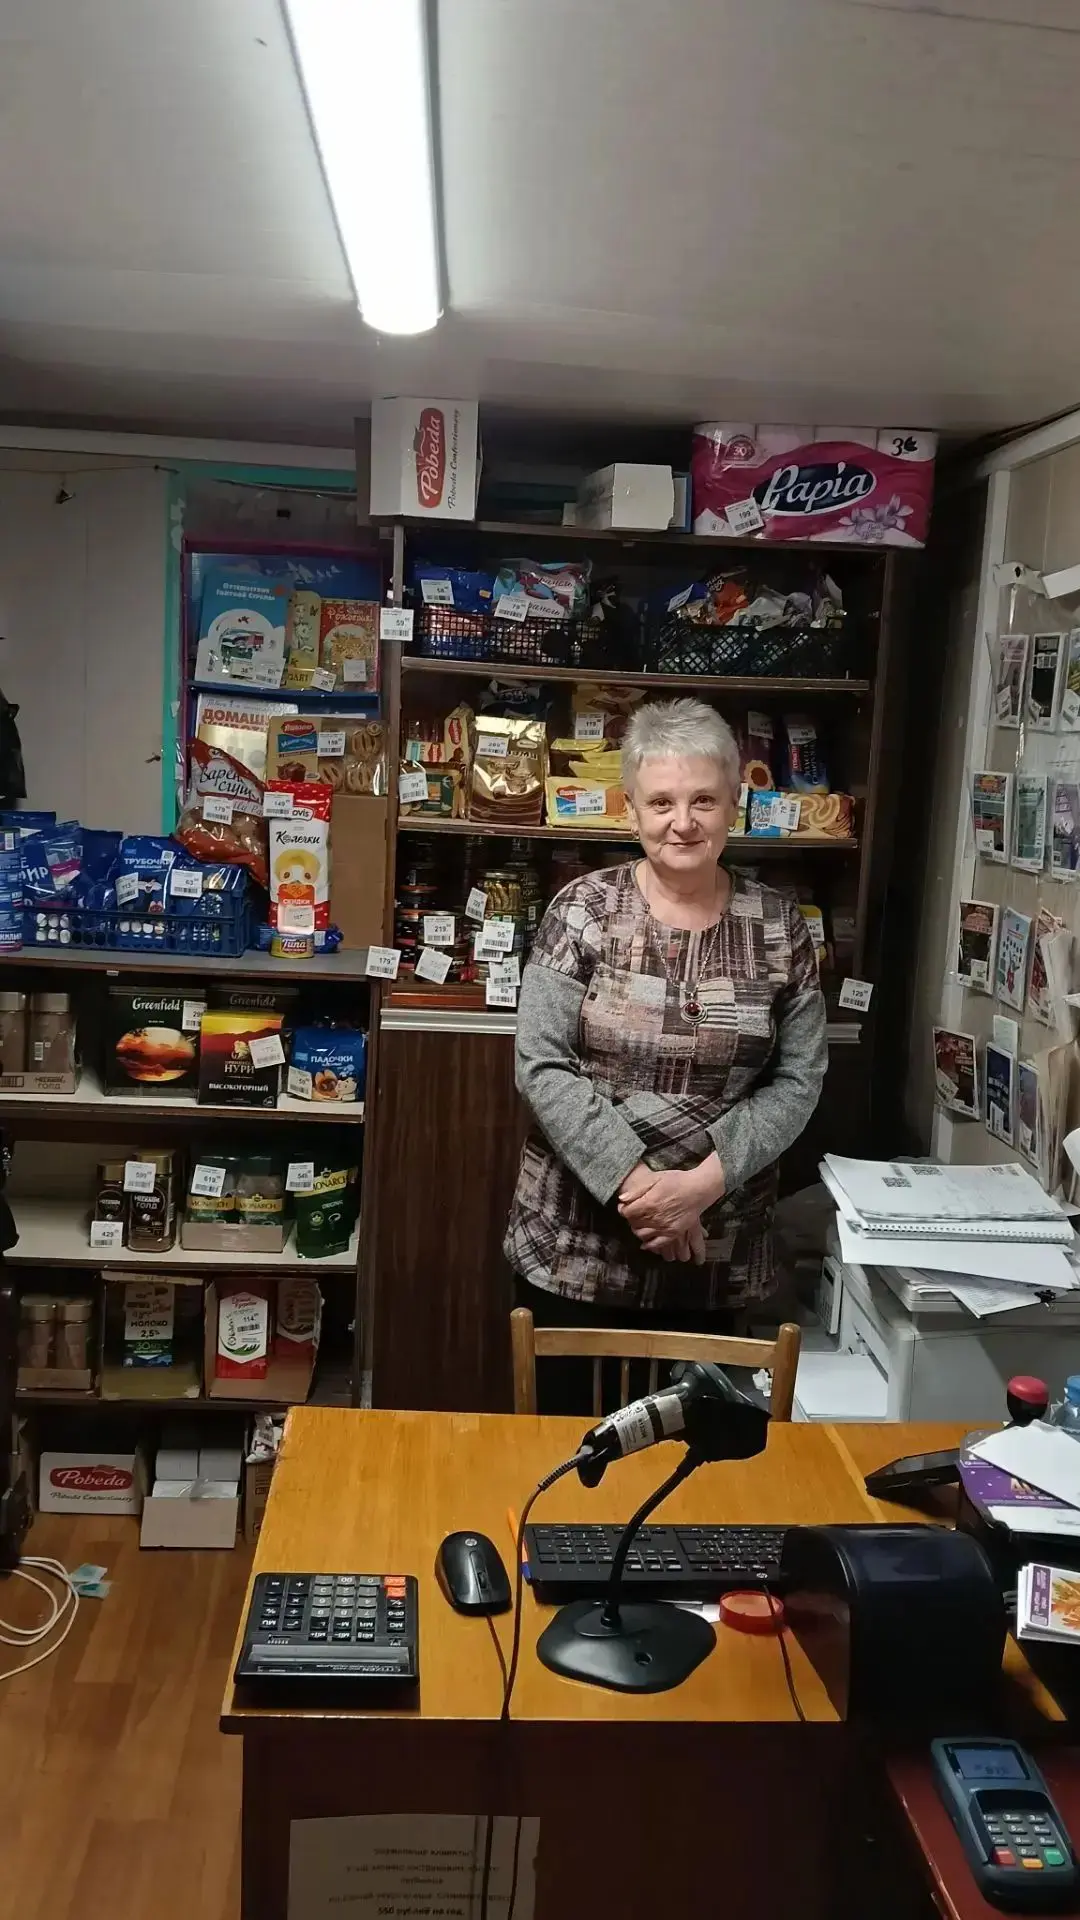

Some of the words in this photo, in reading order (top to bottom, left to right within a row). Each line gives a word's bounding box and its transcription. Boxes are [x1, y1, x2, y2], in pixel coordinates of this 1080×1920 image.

[892, 437, 904, 457] 3
[421, 416, 441, 500] Pobeda
[762, 461, 869, 514] Papia
[202, 709, 269, 725] ДОМАШ
[281, 938, 307, 949] Tuna
[132, 997, 181, 1011] Greenfield
[229, 994, 276, 1006] Greenfield
[311, 1055, 354, 1064] ПАЛОЧКИ
[224, 1064, 255, 1075] НУРИ
[208, 1083, 269, 1092] ВЫСОКОГОРНЫЙ
[57, 1471, 127, 1487] Pobeda
